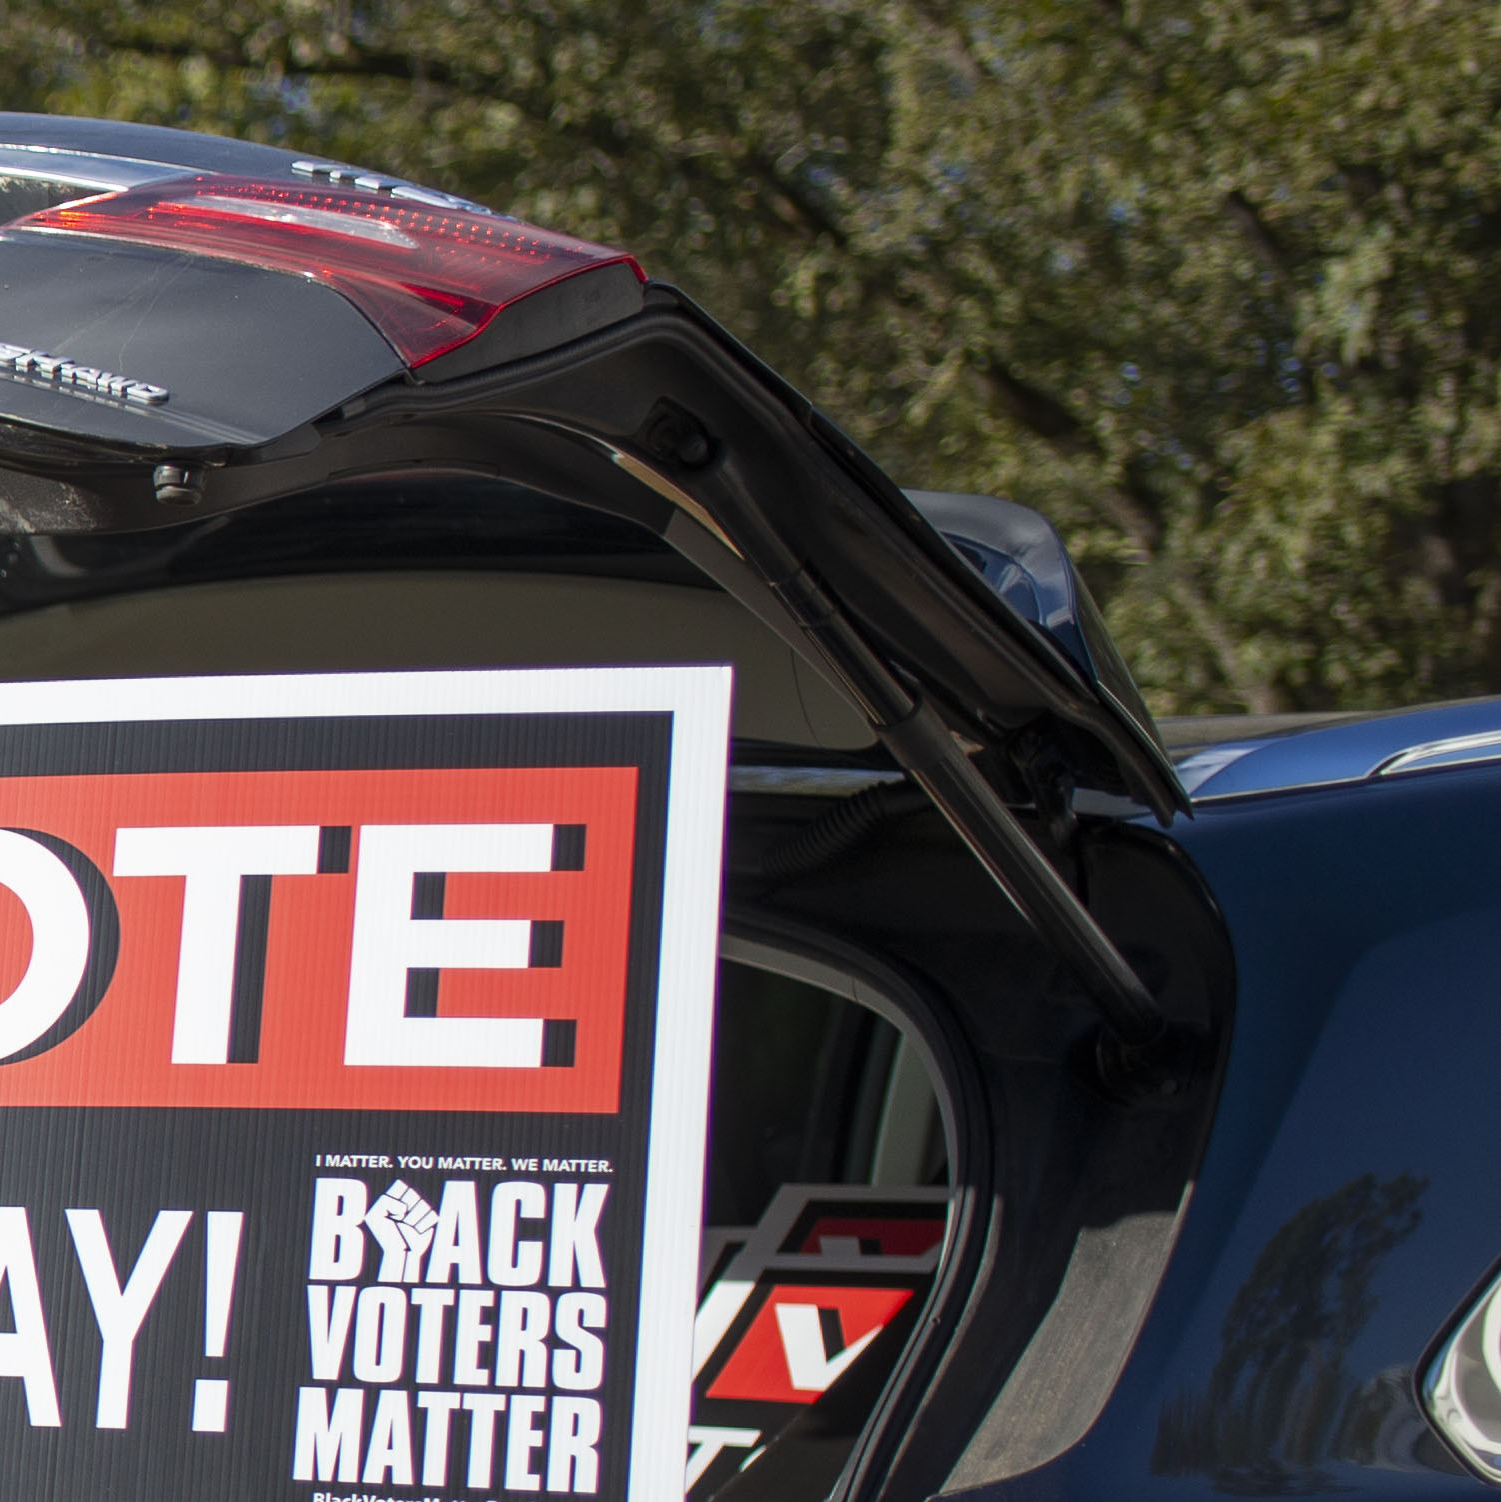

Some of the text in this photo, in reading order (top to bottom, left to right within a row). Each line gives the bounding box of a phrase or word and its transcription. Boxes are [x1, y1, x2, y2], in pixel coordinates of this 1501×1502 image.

[314, 1154, 615, 1173] I MATTER. YOU MATTER. WE MATTER.
[307, 1177, 610, 1288] BACK
[306, 1284, 608, 1391] VOTERS
[292, 1385, 603, 1494] MATTER
